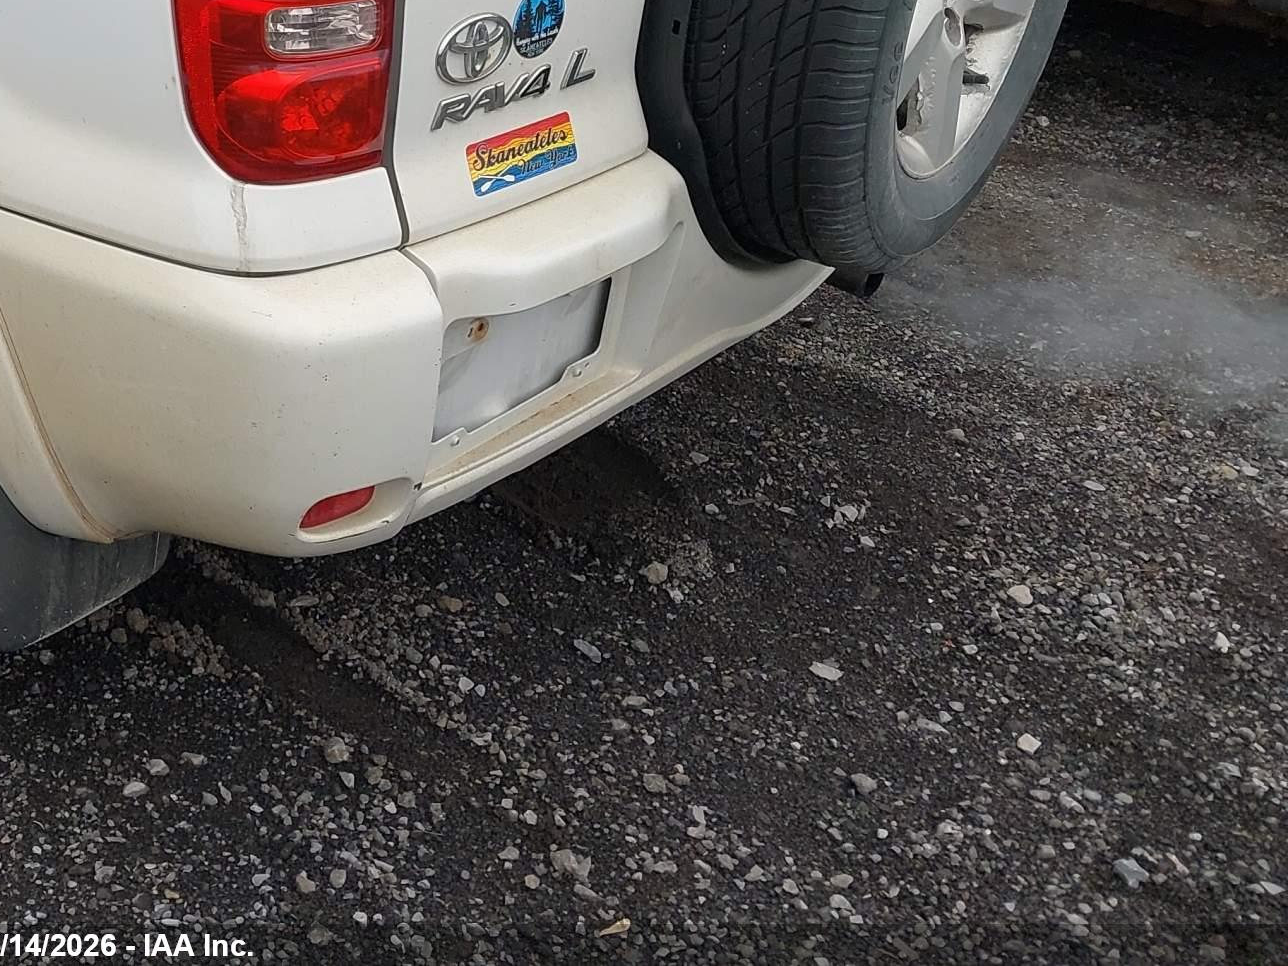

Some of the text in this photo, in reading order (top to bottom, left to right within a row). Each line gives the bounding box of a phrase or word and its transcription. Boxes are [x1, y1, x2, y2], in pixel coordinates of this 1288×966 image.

[430, 47, 597, 132] RAV4 L
[472, 127, 569, 172] Skaneateles
